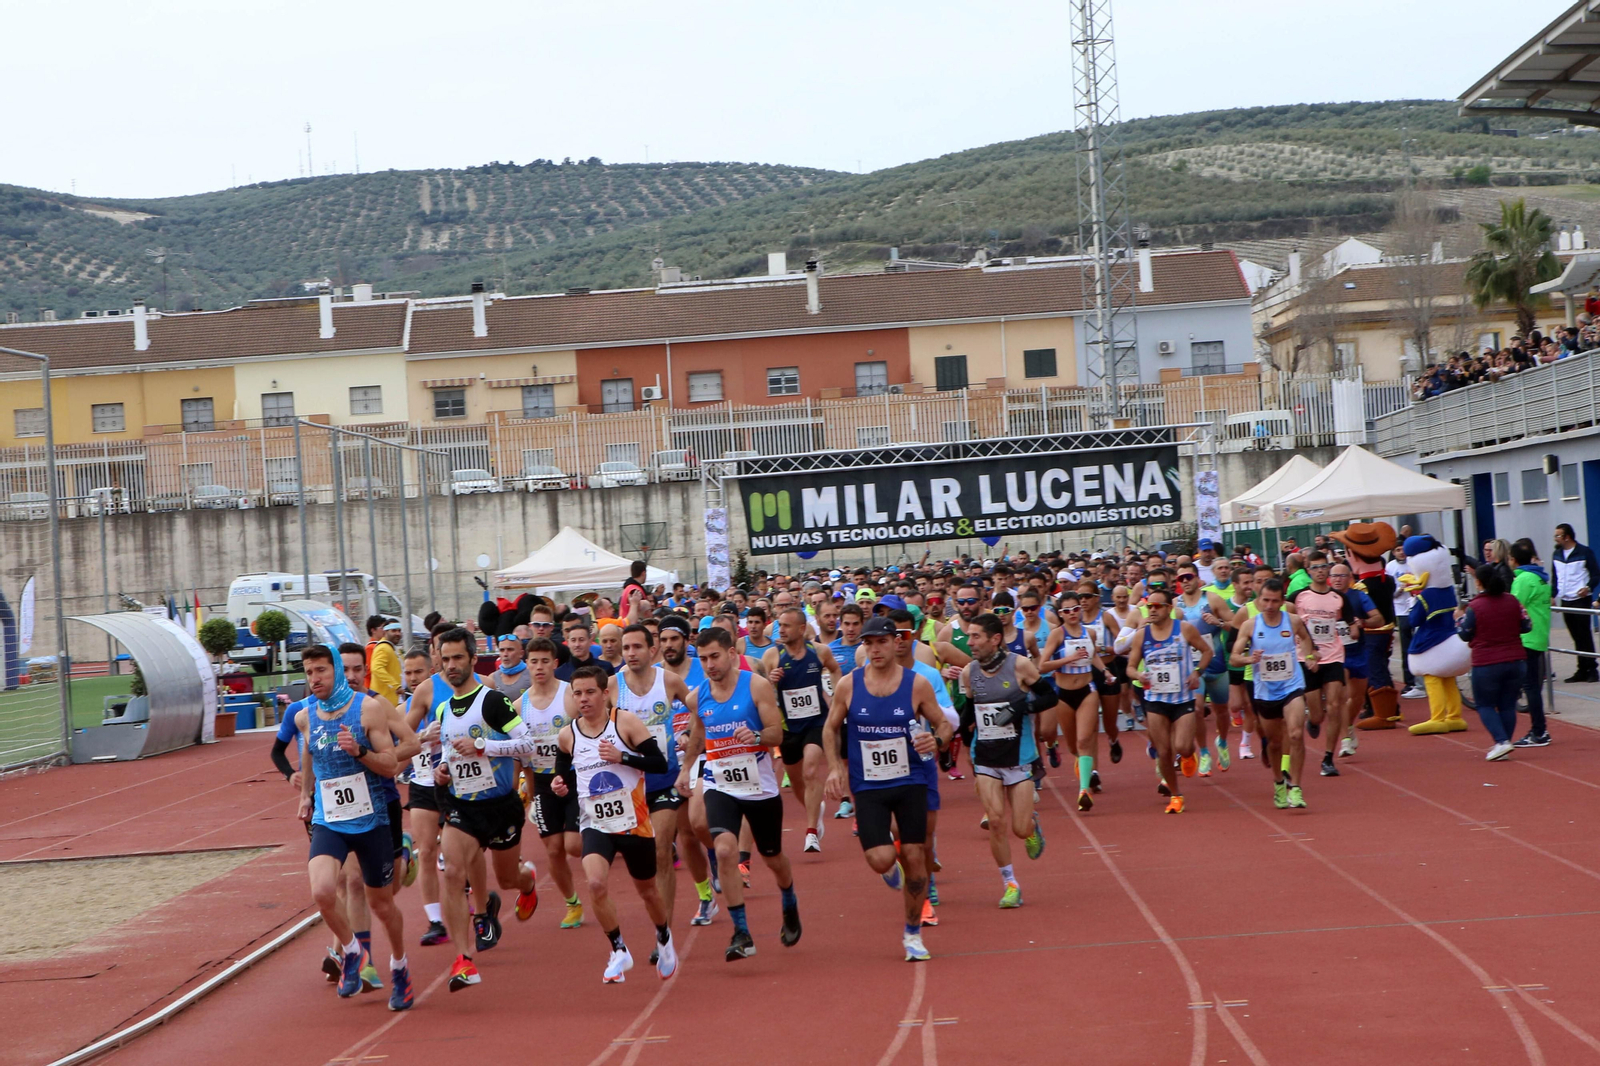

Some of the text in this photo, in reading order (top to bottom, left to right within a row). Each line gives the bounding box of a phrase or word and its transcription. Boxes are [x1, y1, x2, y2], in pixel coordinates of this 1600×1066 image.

[801, 477, 963, 529] MILAR
[978, 460, 1172, 515] LUCENA
[751, 531, 823, 549] NUEVAS
[827, 520, 954, 542] TECNOLOGÍAS
[974, 503, 1174, 532] ELECTRODOMÉSTICOS
[1265, 660, 1287, 672] 889
[1157, 672, 1170, 683] 89
[791, 694, 812, 708] 930
[982, 712, 1001, 727] 61
[857, 725, 907, 734] TROTASIERRA
[536, 744, 558, 757] 429
[717, 747, 747, 758] Lucena
[871, 749, 898, 766] 916
[456, 761, 482, 779] 226
[722, 766, 750, 783] 361
[334, 787, 355, 806] 30
[594, 800, 625, 819] 933
